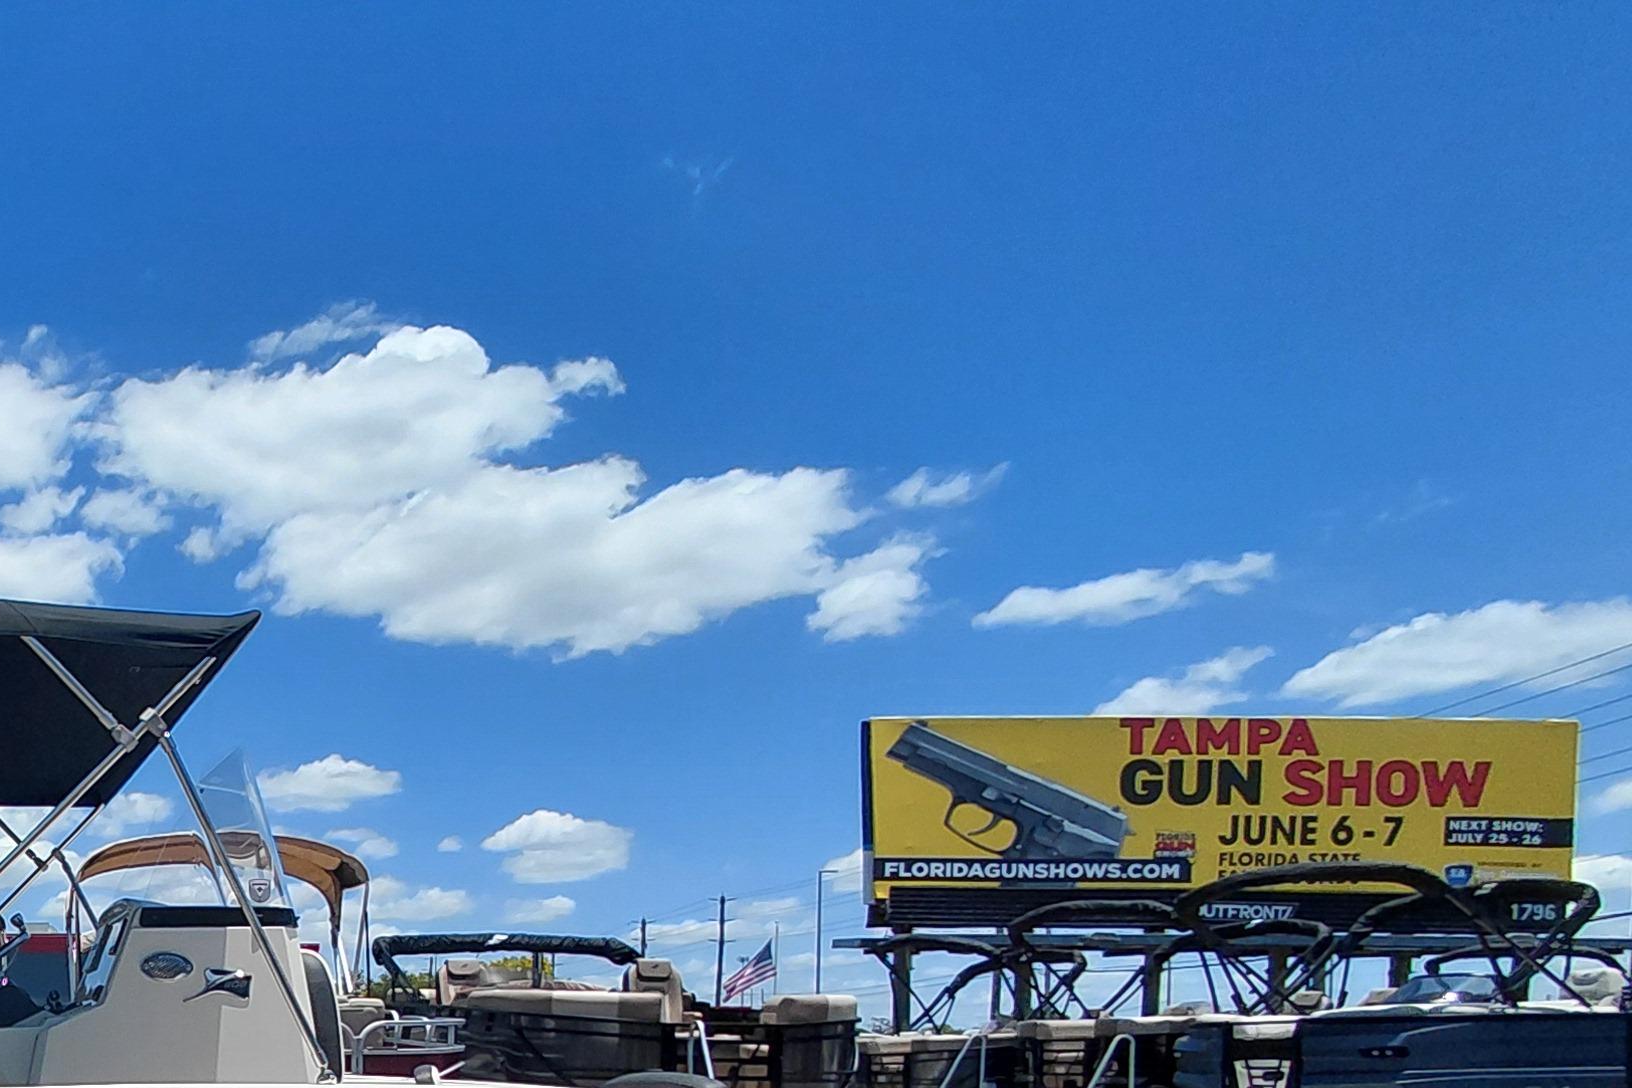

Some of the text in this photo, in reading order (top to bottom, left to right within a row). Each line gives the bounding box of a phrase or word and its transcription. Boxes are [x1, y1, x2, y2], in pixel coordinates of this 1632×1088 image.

[1119, 718, 1319, 755] TAMPA
[1120, 759, 1492, 807] GUN SHOW
[1218, 815, 1318, 846] JUNE
[1449, 820, 1543, 832] NEXT SHOW:
[1448, 833, 1484, 843] JULY
[1488, 834, 1509, 844] 25
[1521, 835, 1542, 845] 26
[1219, 852, 1299, 867] FLORIDA
[884, 862, 1180, 879] FLORIDAGUNSHOWS.COM
[1511, 904, 1556, 920] 1796
